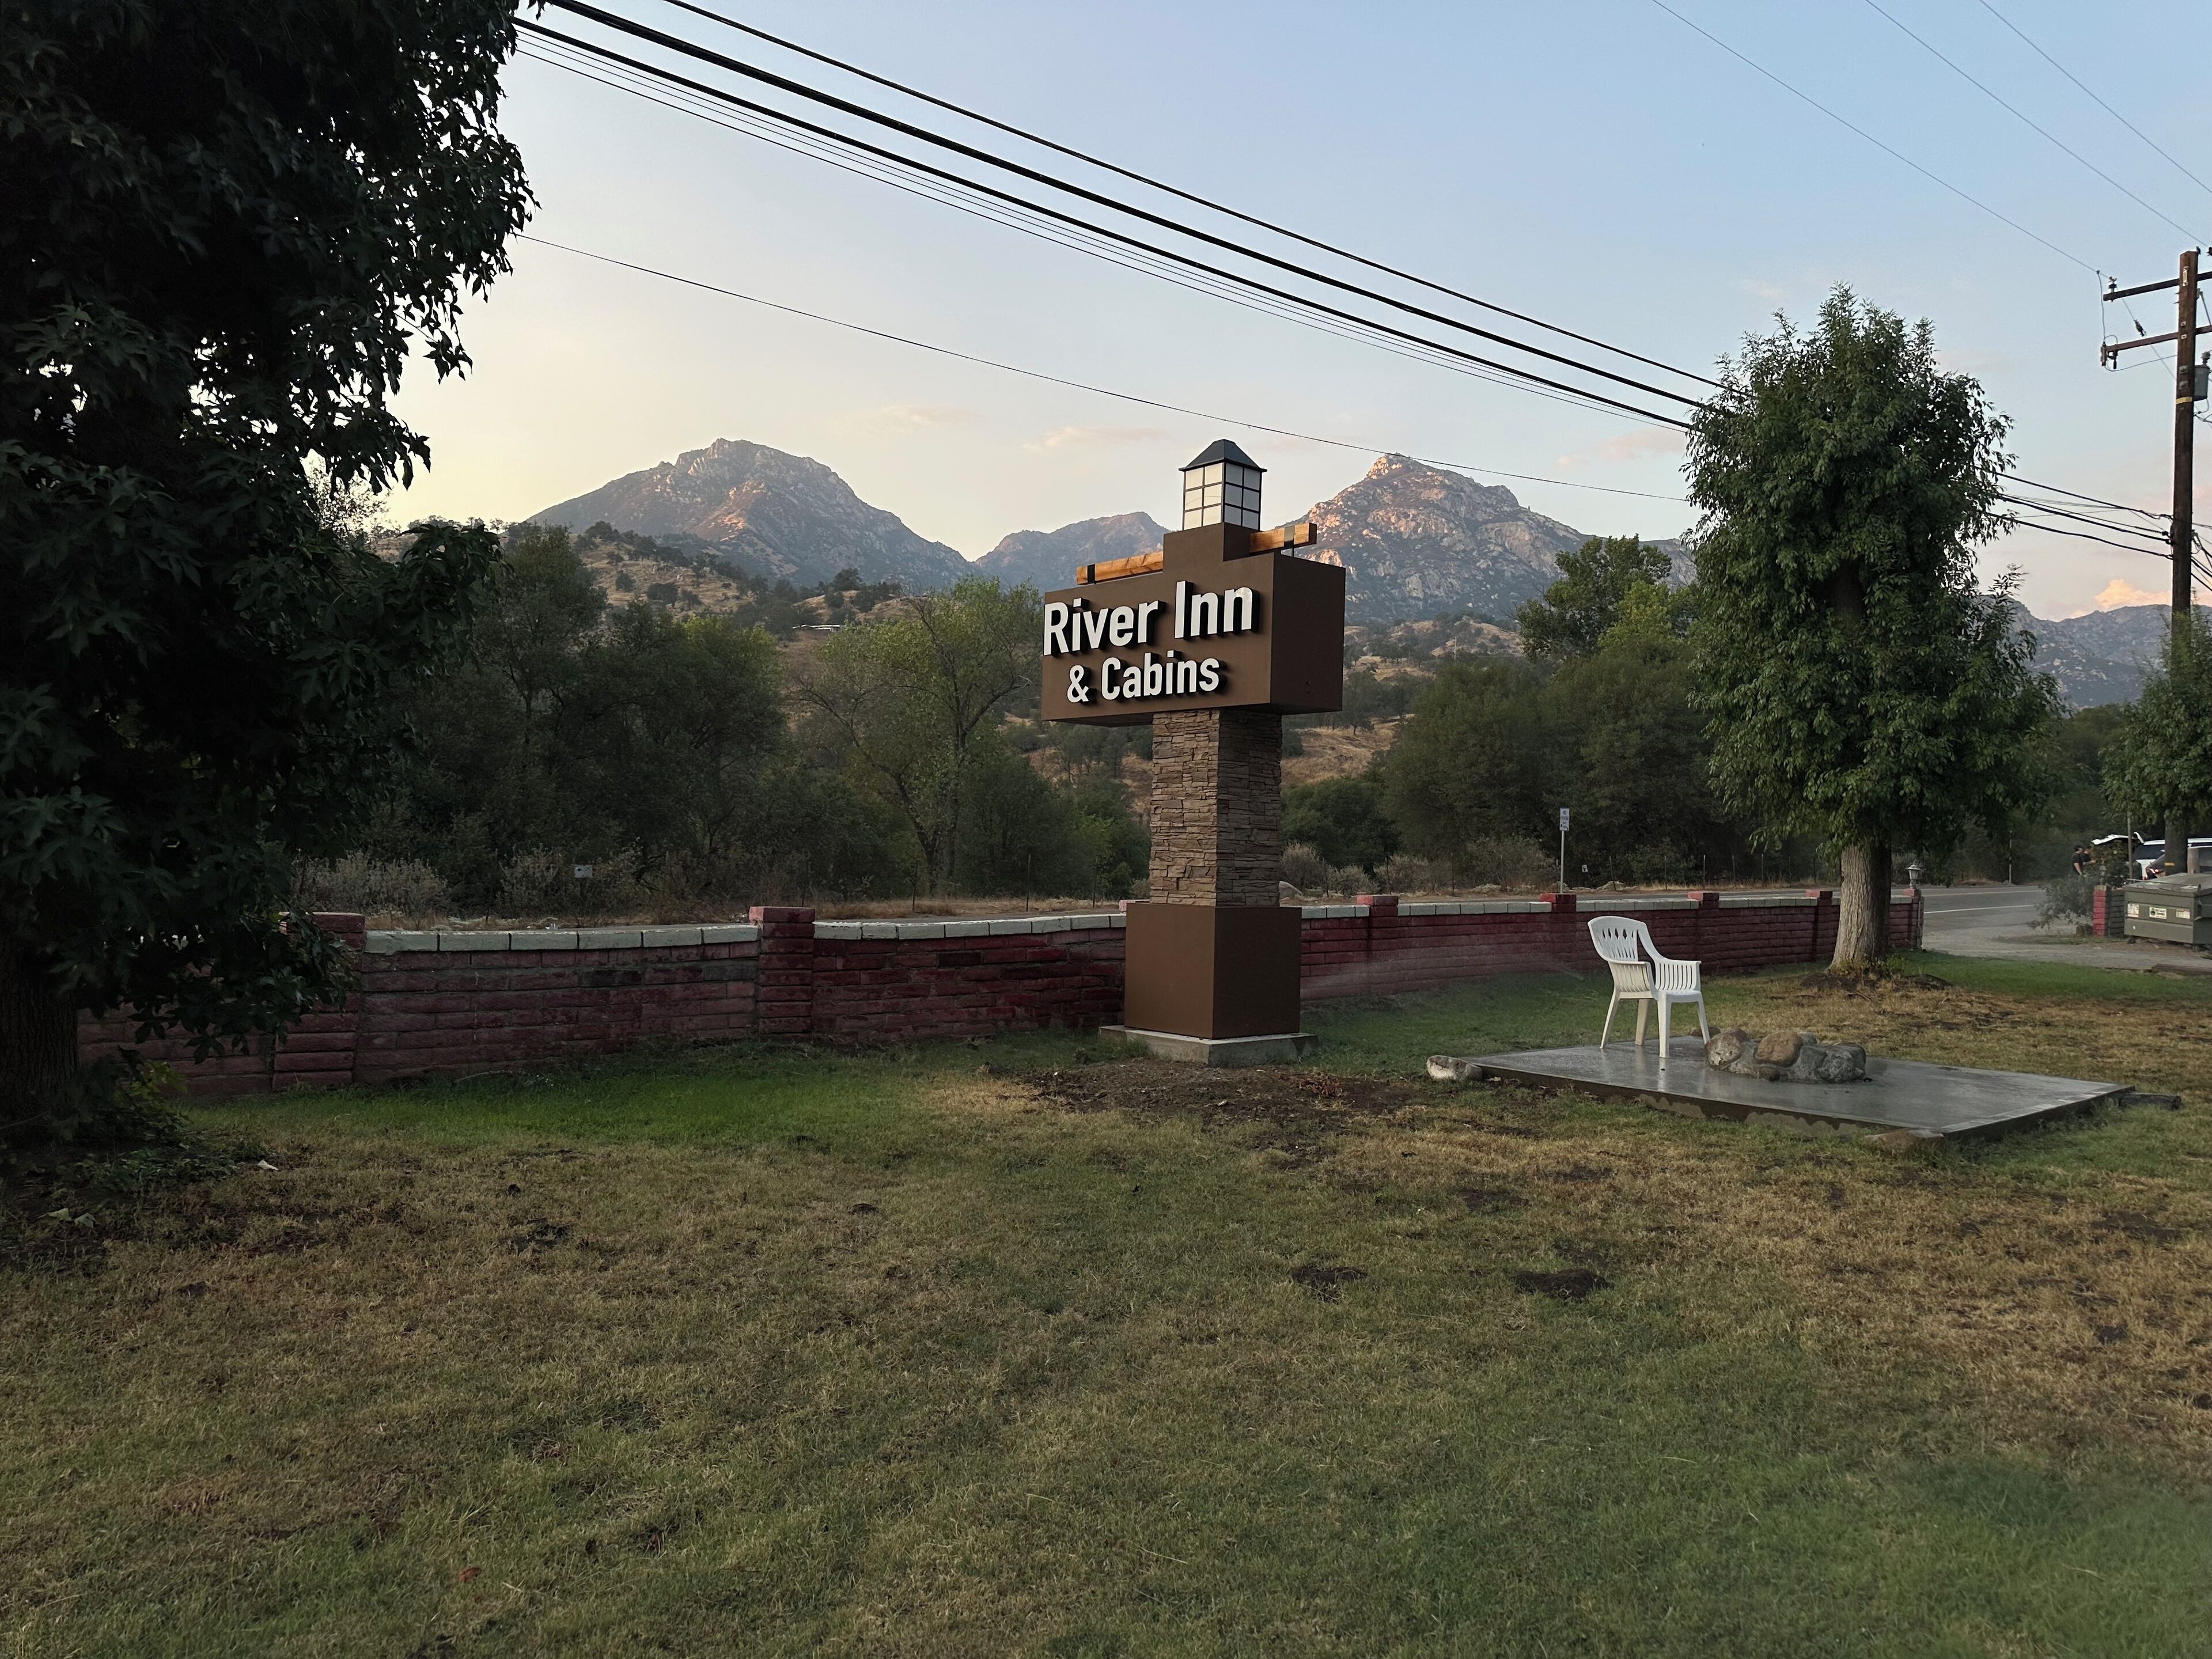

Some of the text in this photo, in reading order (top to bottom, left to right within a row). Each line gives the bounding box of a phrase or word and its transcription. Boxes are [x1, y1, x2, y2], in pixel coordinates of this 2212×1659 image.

[1043, 580, 1254, 656] River Inn
[1067, 650, 1221, 703] & Cabins
